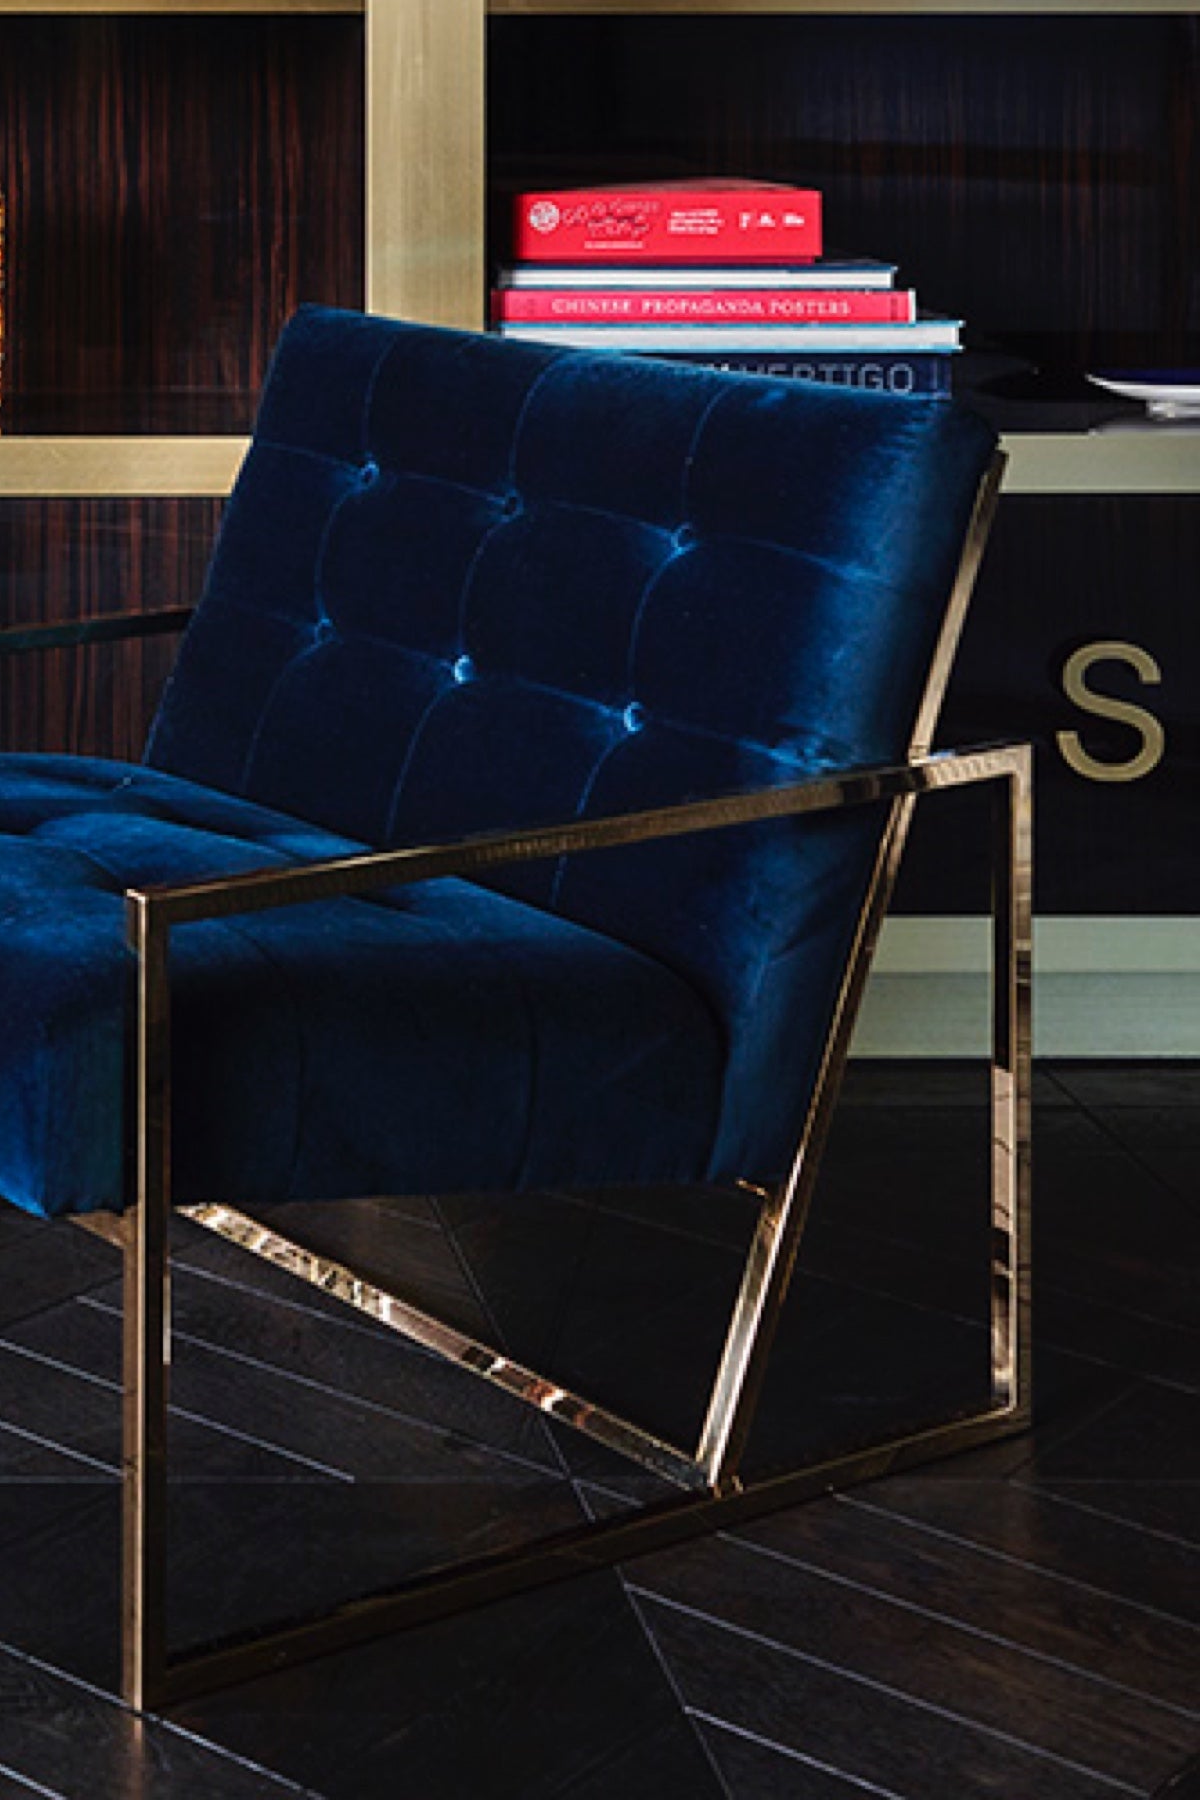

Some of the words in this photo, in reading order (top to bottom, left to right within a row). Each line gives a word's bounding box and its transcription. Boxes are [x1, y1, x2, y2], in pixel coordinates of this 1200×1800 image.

[552, 299, 631, 314] CHINESE
[641, 300, 763, 316] PROPAGANDA
[770, 300, 849, 316] POSTERS
[1056, 640, 1165, 783] S
